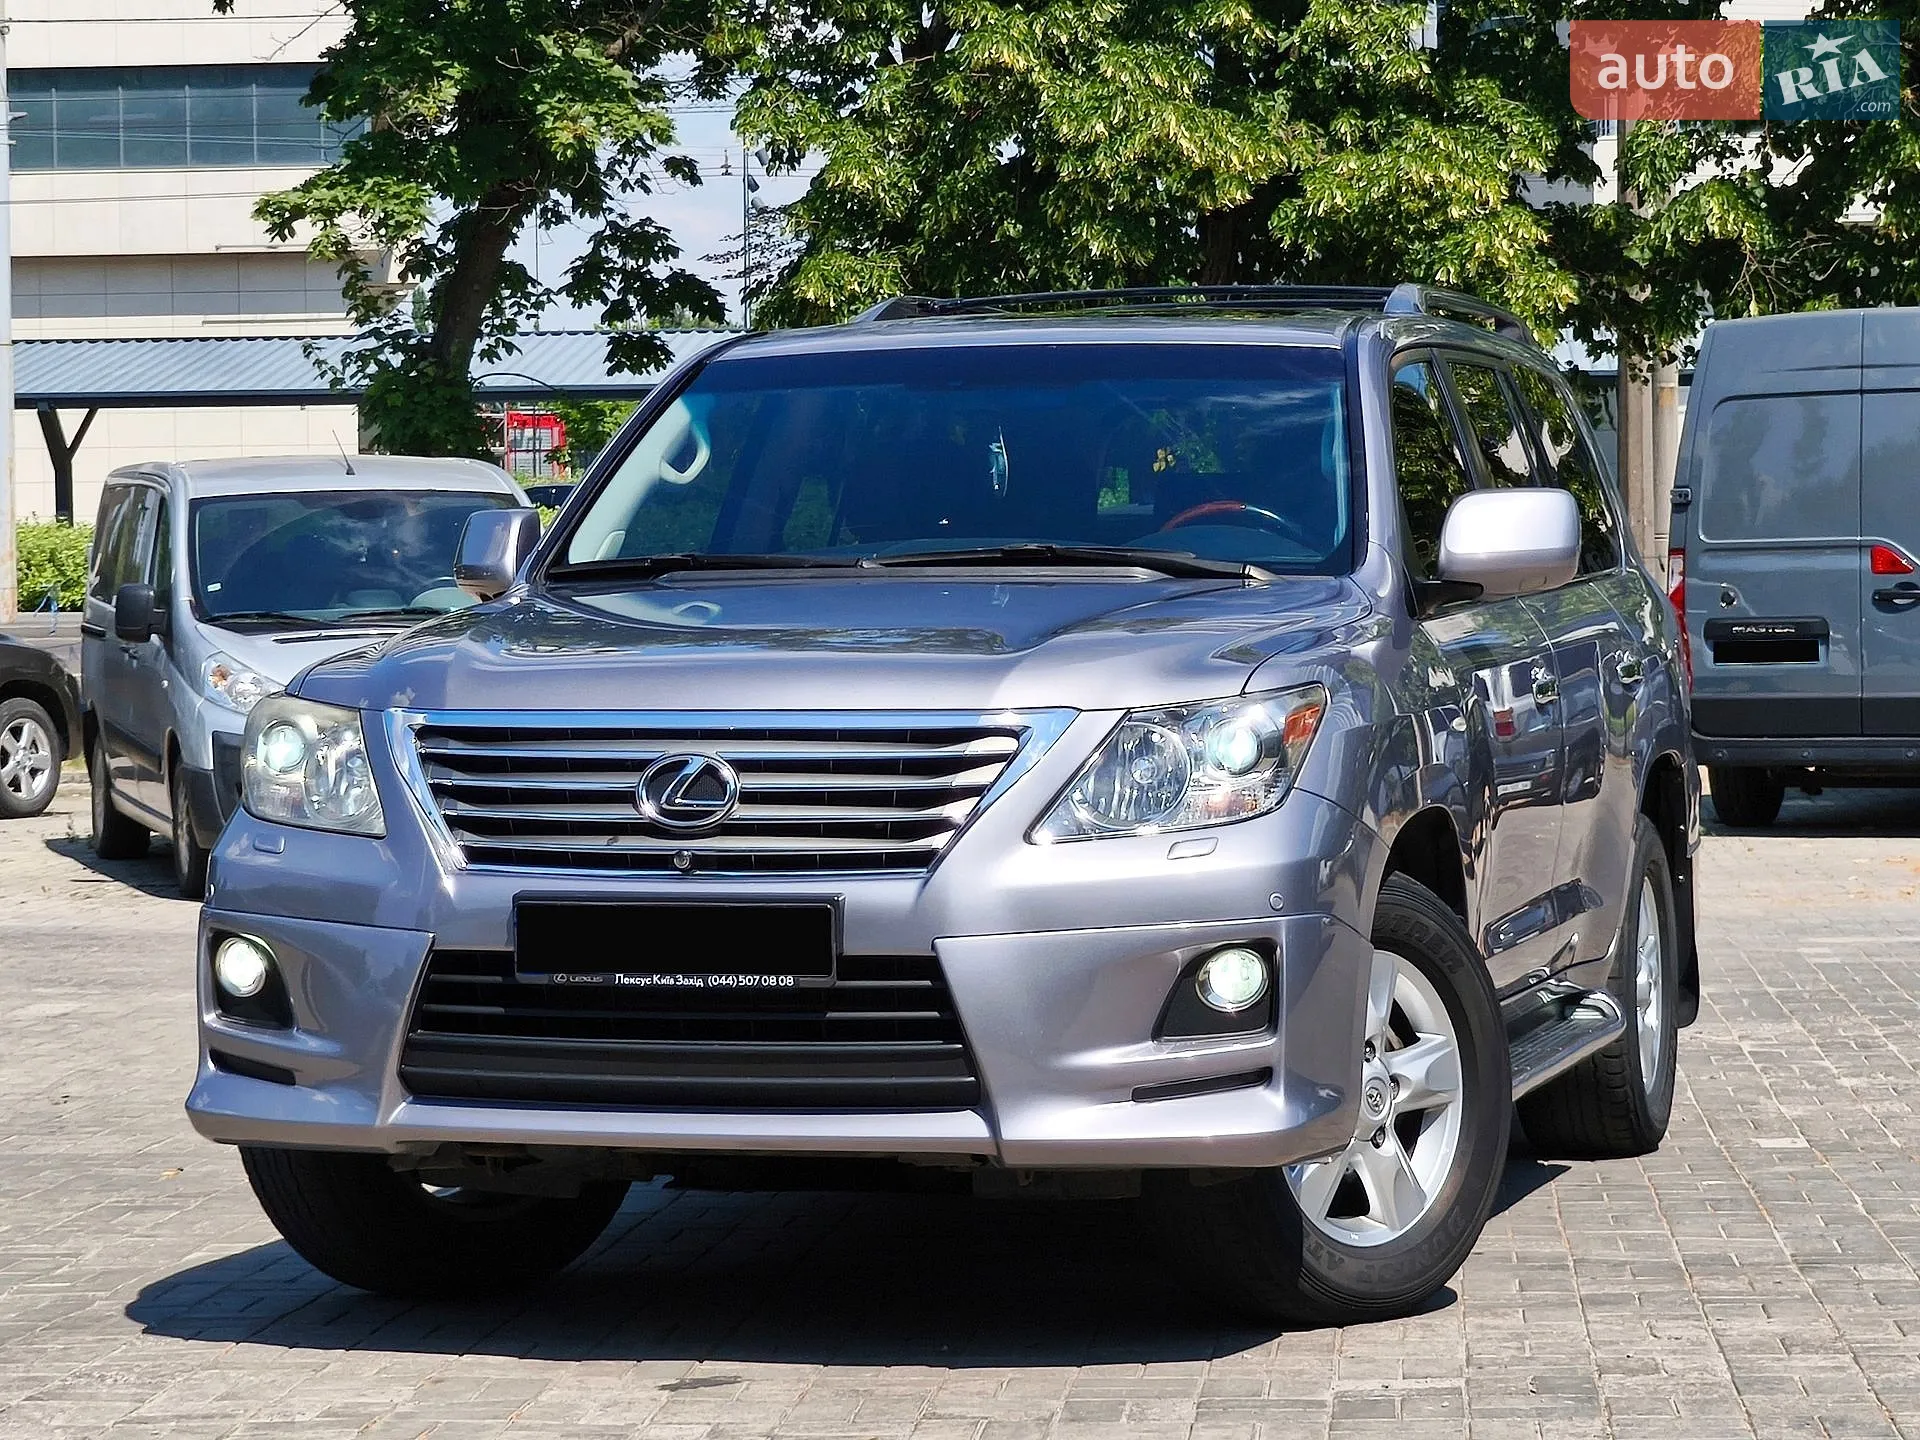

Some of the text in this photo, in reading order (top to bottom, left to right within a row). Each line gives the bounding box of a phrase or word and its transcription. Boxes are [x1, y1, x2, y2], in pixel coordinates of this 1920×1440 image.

[614, 973, 795, 987] Лексус Київ Захід (044) 507 08 08
